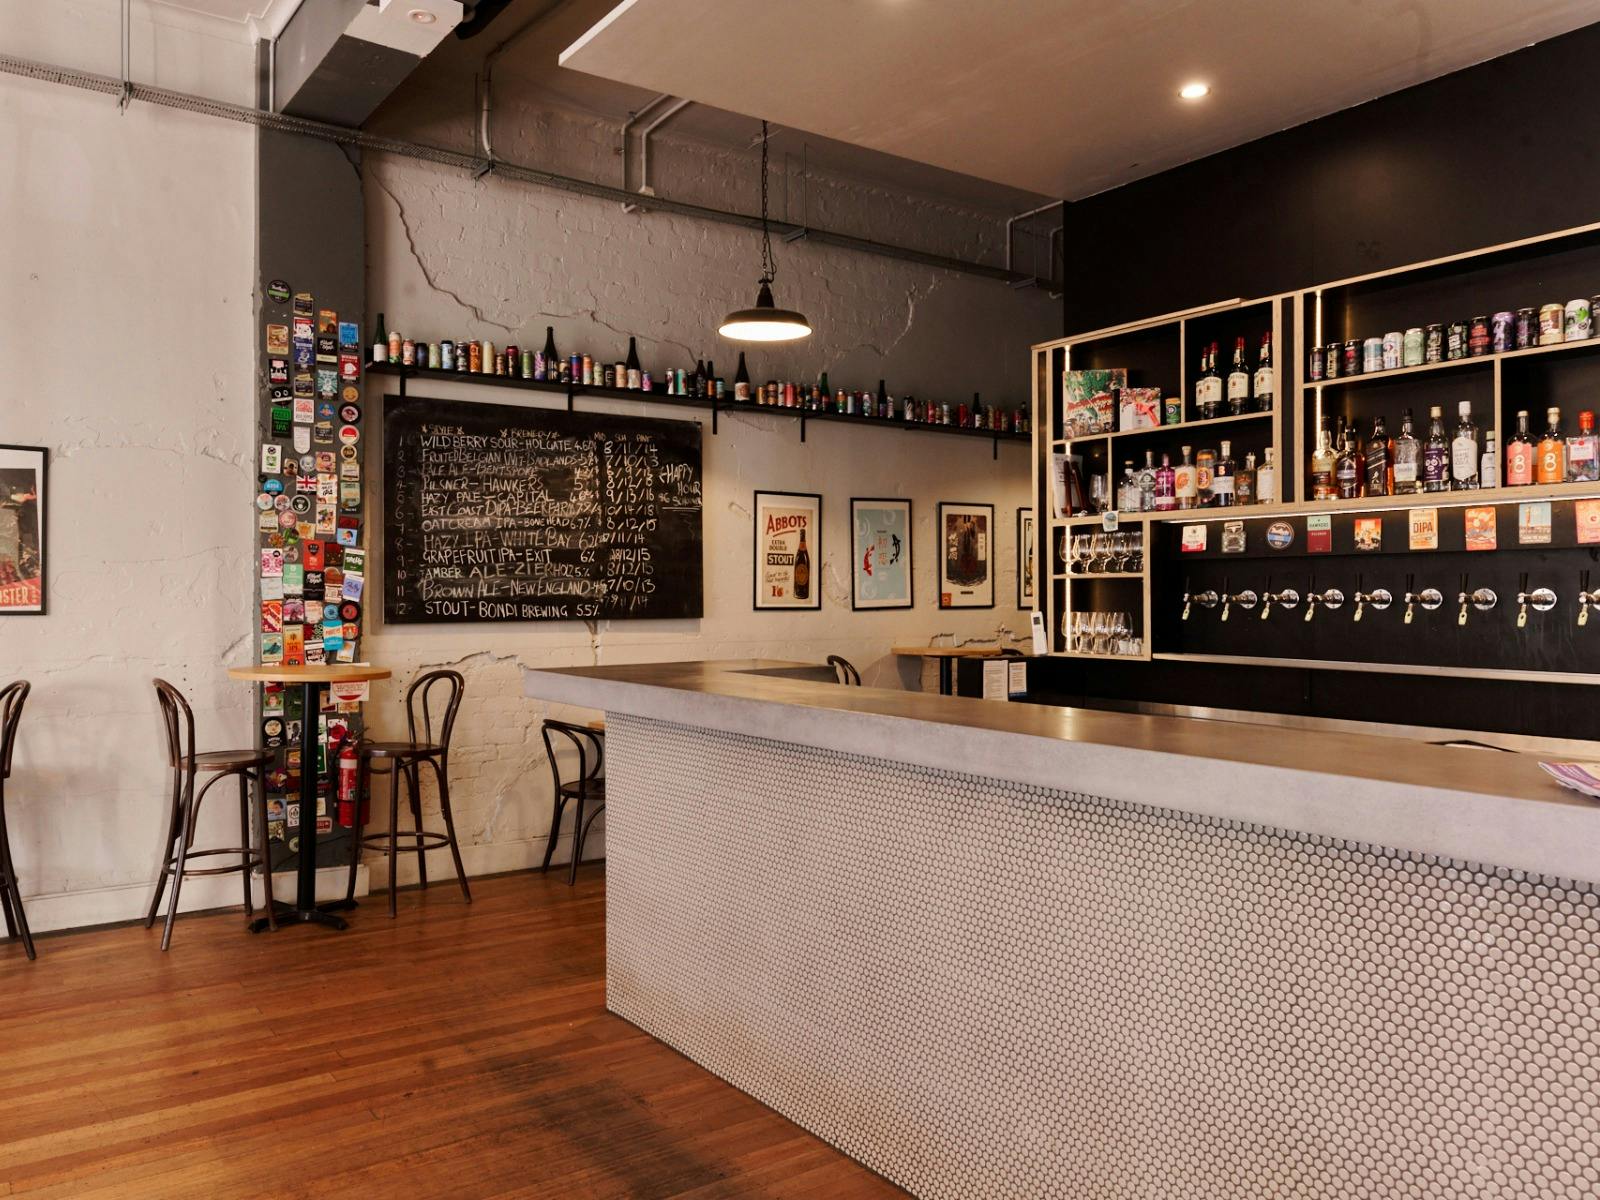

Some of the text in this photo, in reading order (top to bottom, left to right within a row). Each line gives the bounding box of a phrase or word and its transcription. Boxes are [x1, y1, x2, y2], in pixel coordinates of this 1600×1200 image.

[428, 424, 454, 434] STYLE
[420, 435, 450, 449] WILD
[452, 435, 487, 448] BERRY
[665, 463, 694, 484] HAPPY
[422, 475, 469, 491] PILSNER
[483, 477, 544, 493] HAWKERS
[677, 481, 701, 498] HOUR
[421, 491, 450, 505] HAZY
[421, 502, 446, 517] EAST
[447, 501, 485, 516] COAST
[766, 513, 808, 535] ABBOTS
[1413, 522, 1433, 533] DIPA
[423, 534, 459, 551] HAZY
[545, 526, 572, 550] BAY
[422, 549, 496, 565] GRAPEFRUIT
[580, 548, 596, 563] 6%
[768, 555, 793, 565] STOUT
[424, 565, 465, 580] AMBER
[422, 577, 474, 601] BROWN
[537, 576, 591, 596] ENGLAND
[521, 604, 569, 619] BREWING
